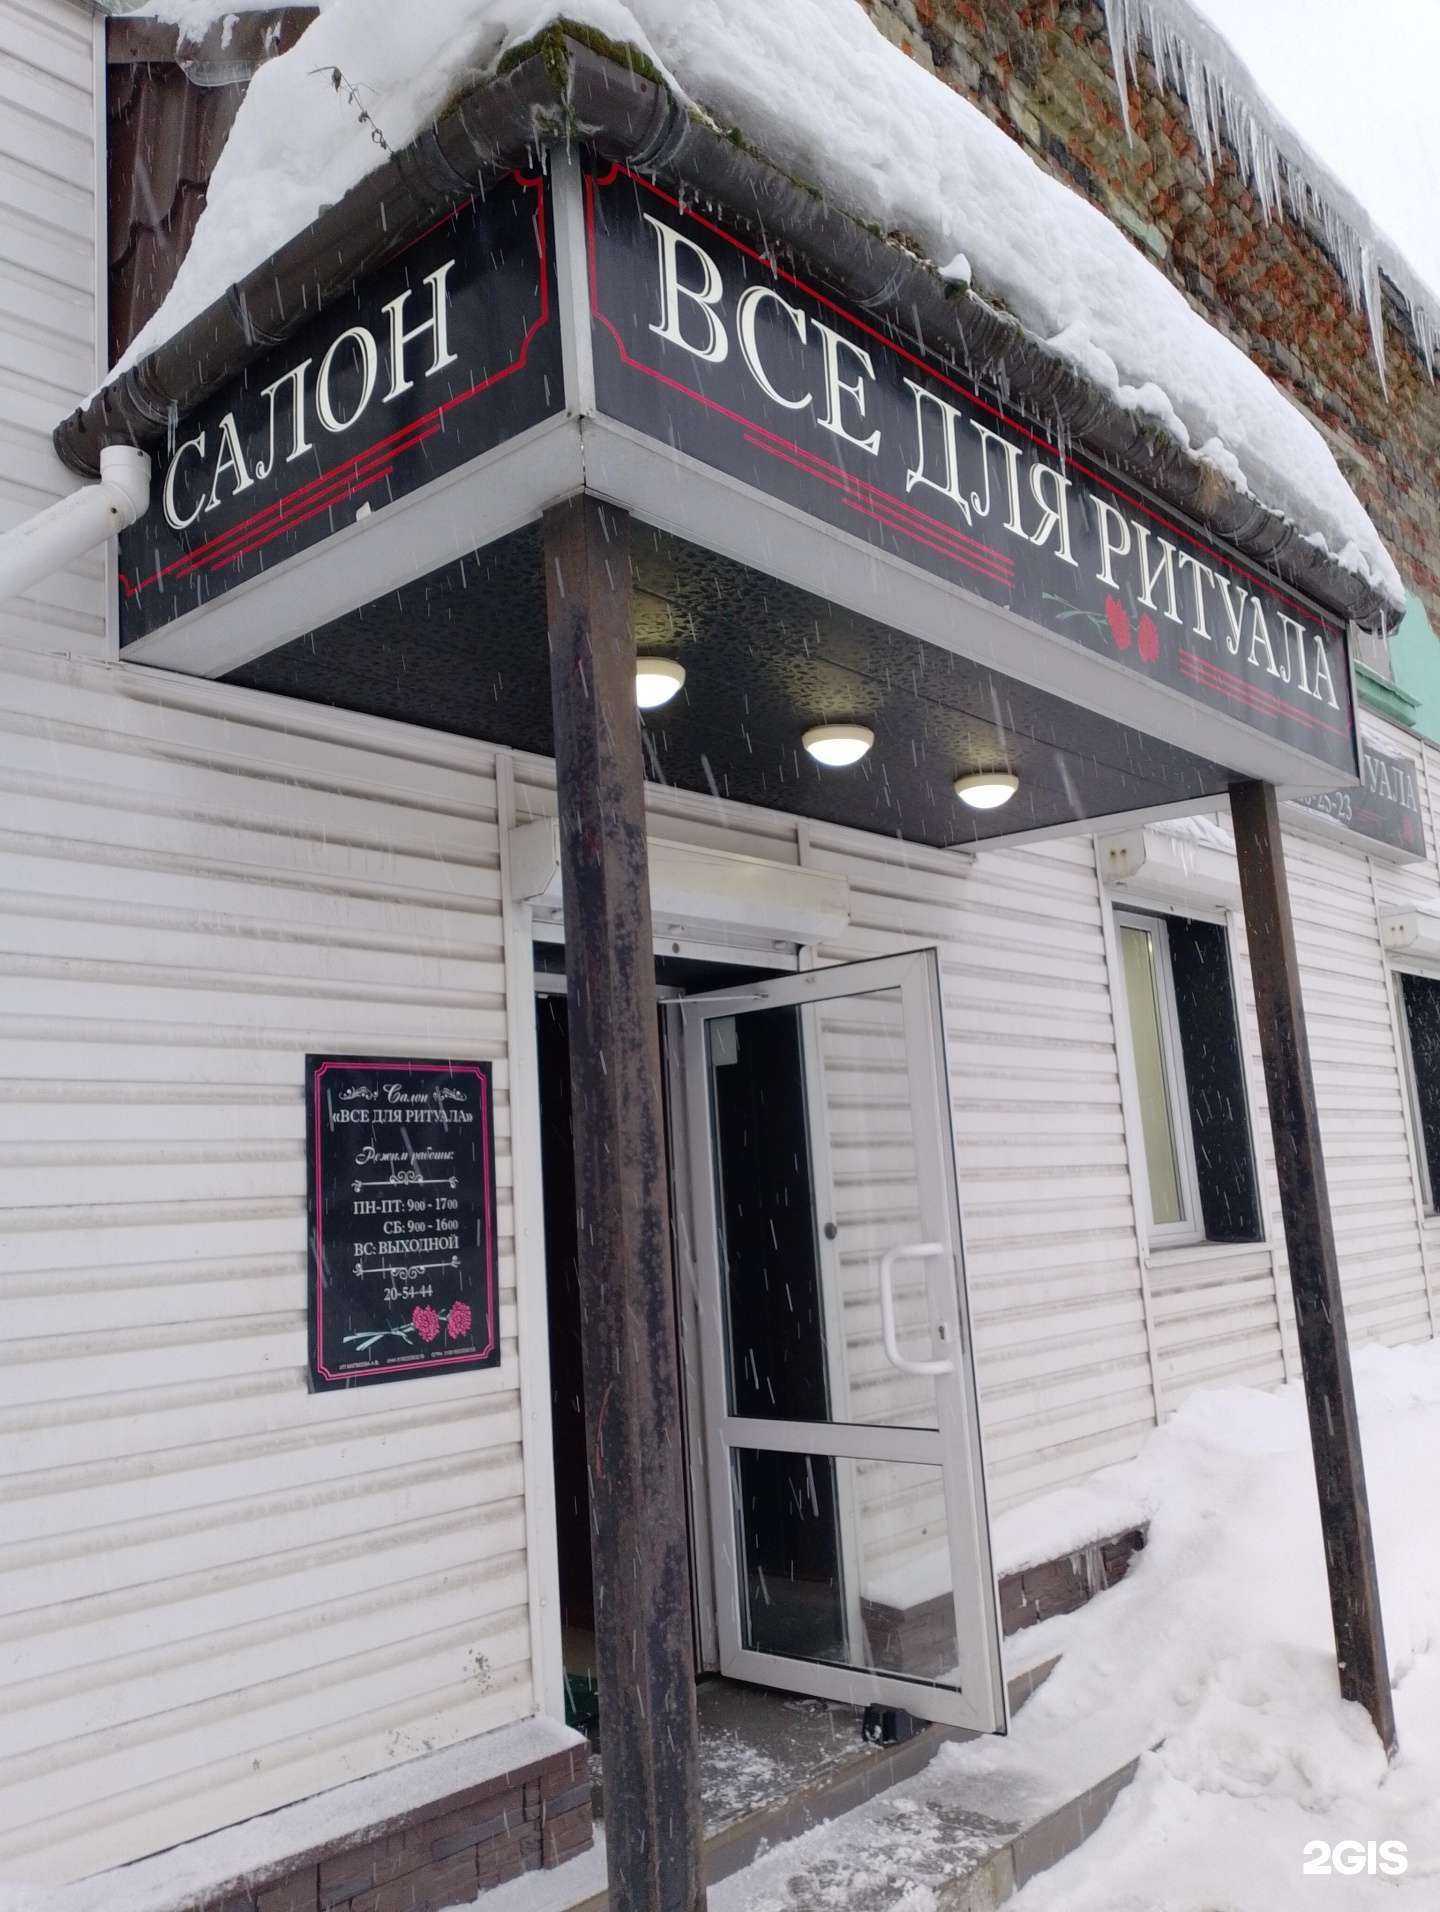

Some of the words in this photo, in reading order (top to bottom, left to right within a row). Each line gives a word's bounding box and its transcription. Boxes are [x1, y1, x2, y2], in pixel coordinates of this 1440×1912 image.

[163, 259, 458, 530] САЛОН
[644, 212, 881, 456] ВСЕ
[902, 377, 1079, 567] ДЛЯ
[1089, 494, 1341, 709] РИТУАЛА
[1362, 753, 1418, 813] УАЛА
[382, 1083, 429, 1104] Салон
[332, 1109, 370, 1123] «ВСЕ
[371, 1109, 401, 1124] ДЛЯ
[405, 1109, 474, 1123] РИТУАЛА»
[355, 1146, 408, 1165] Режим
[353, 1199, 405, 1215] ПН-ПТ:
[383, 1221, 406, 1235] СБ:
[378, 1234, 460, 1254] ВЫХОДНОЙ
[383, 1284, 434, 1301] 20-54-44
